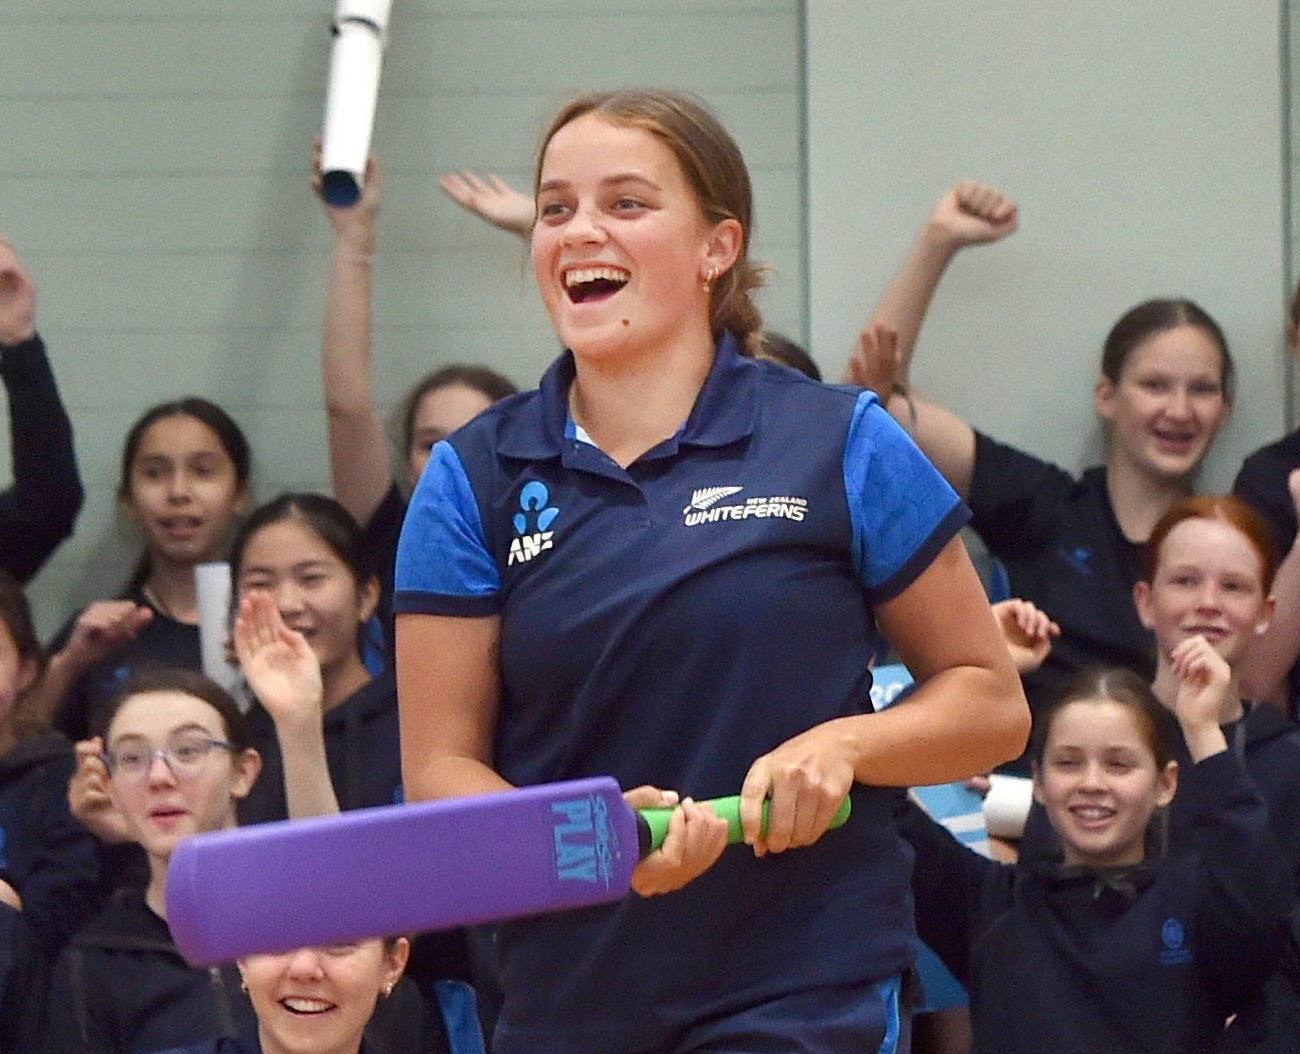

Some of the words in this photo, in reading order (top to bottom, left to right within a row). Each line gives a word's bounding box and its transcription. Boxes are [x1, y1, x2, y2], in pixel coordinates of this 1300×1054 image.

[685, 504, 808, 526] WHITEFERNS
[508, 531, 554, 566] ANZ
[552, 798, 597, 883] PLAY
